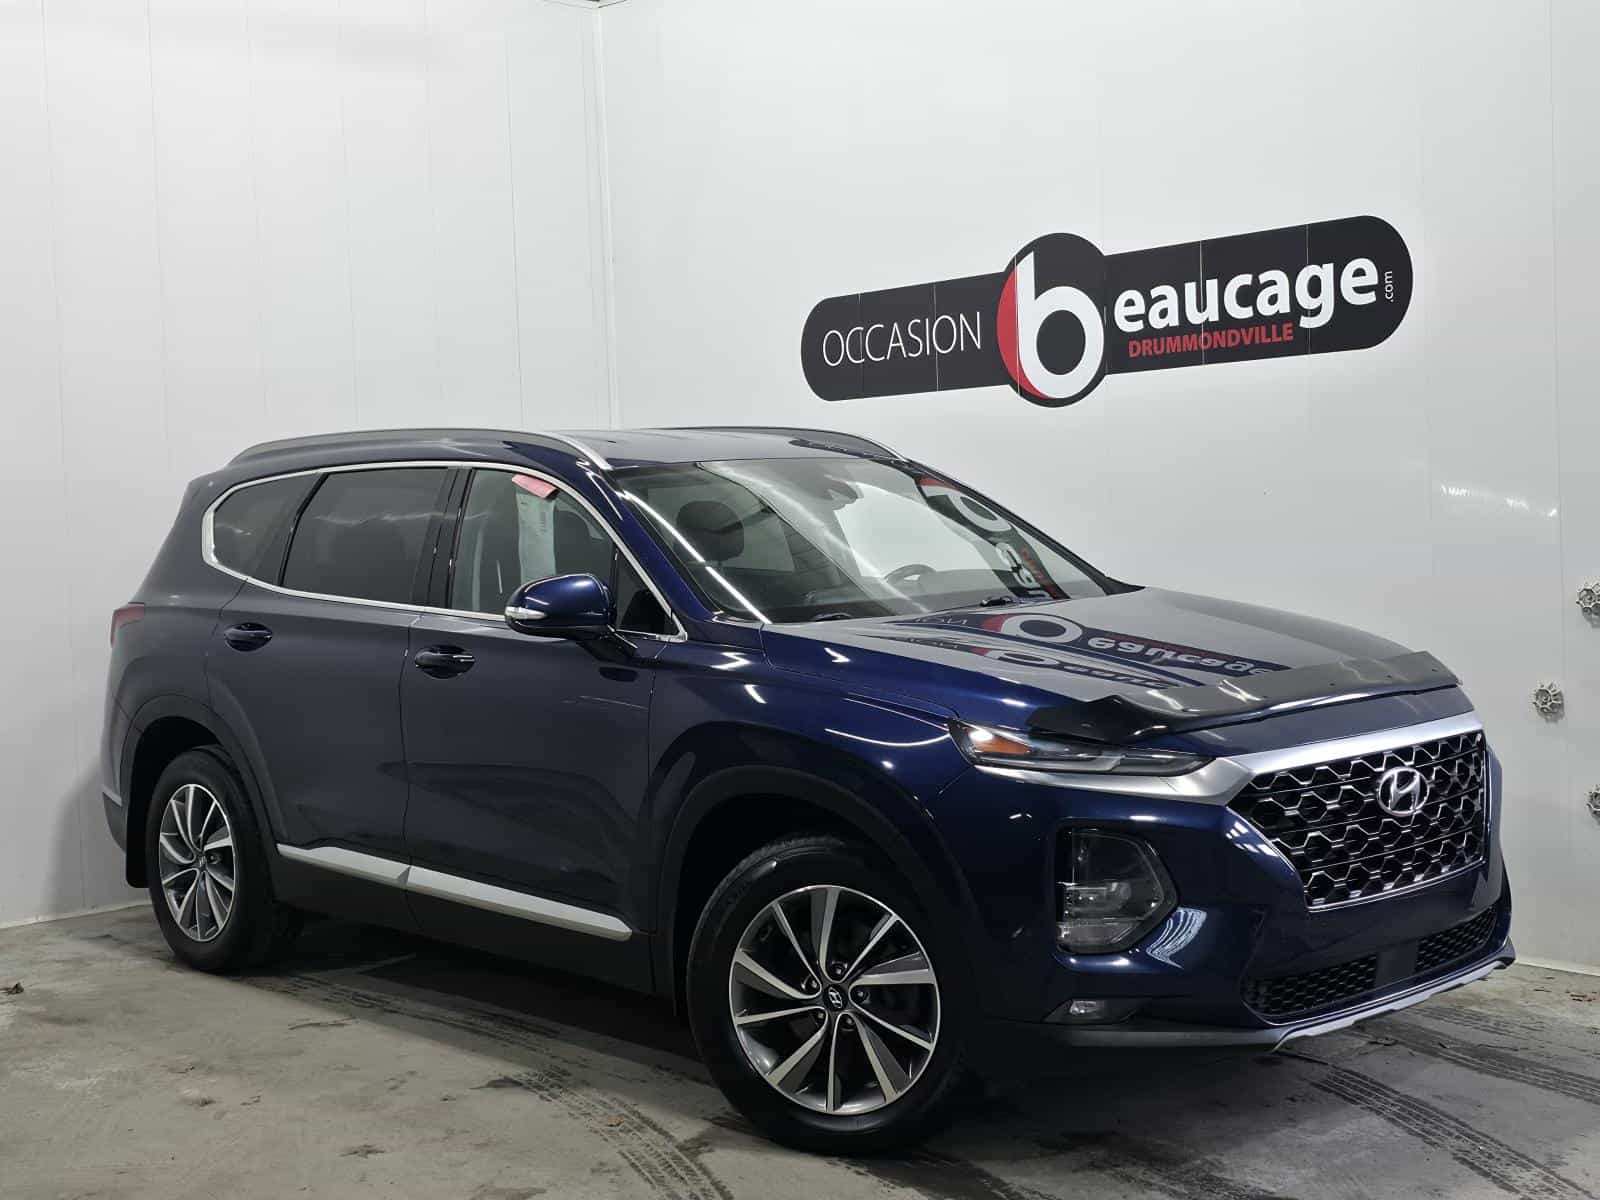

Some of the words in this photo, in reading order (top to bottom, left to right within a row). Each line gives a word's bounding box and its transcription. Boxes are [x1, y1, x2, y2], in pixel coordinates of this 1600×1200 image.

[822, 311, 982, 367] OCCASION
[1384, 270, 1394, 303] .com
[1128, 322, 1294, 358] DRUMMONDVILLE
